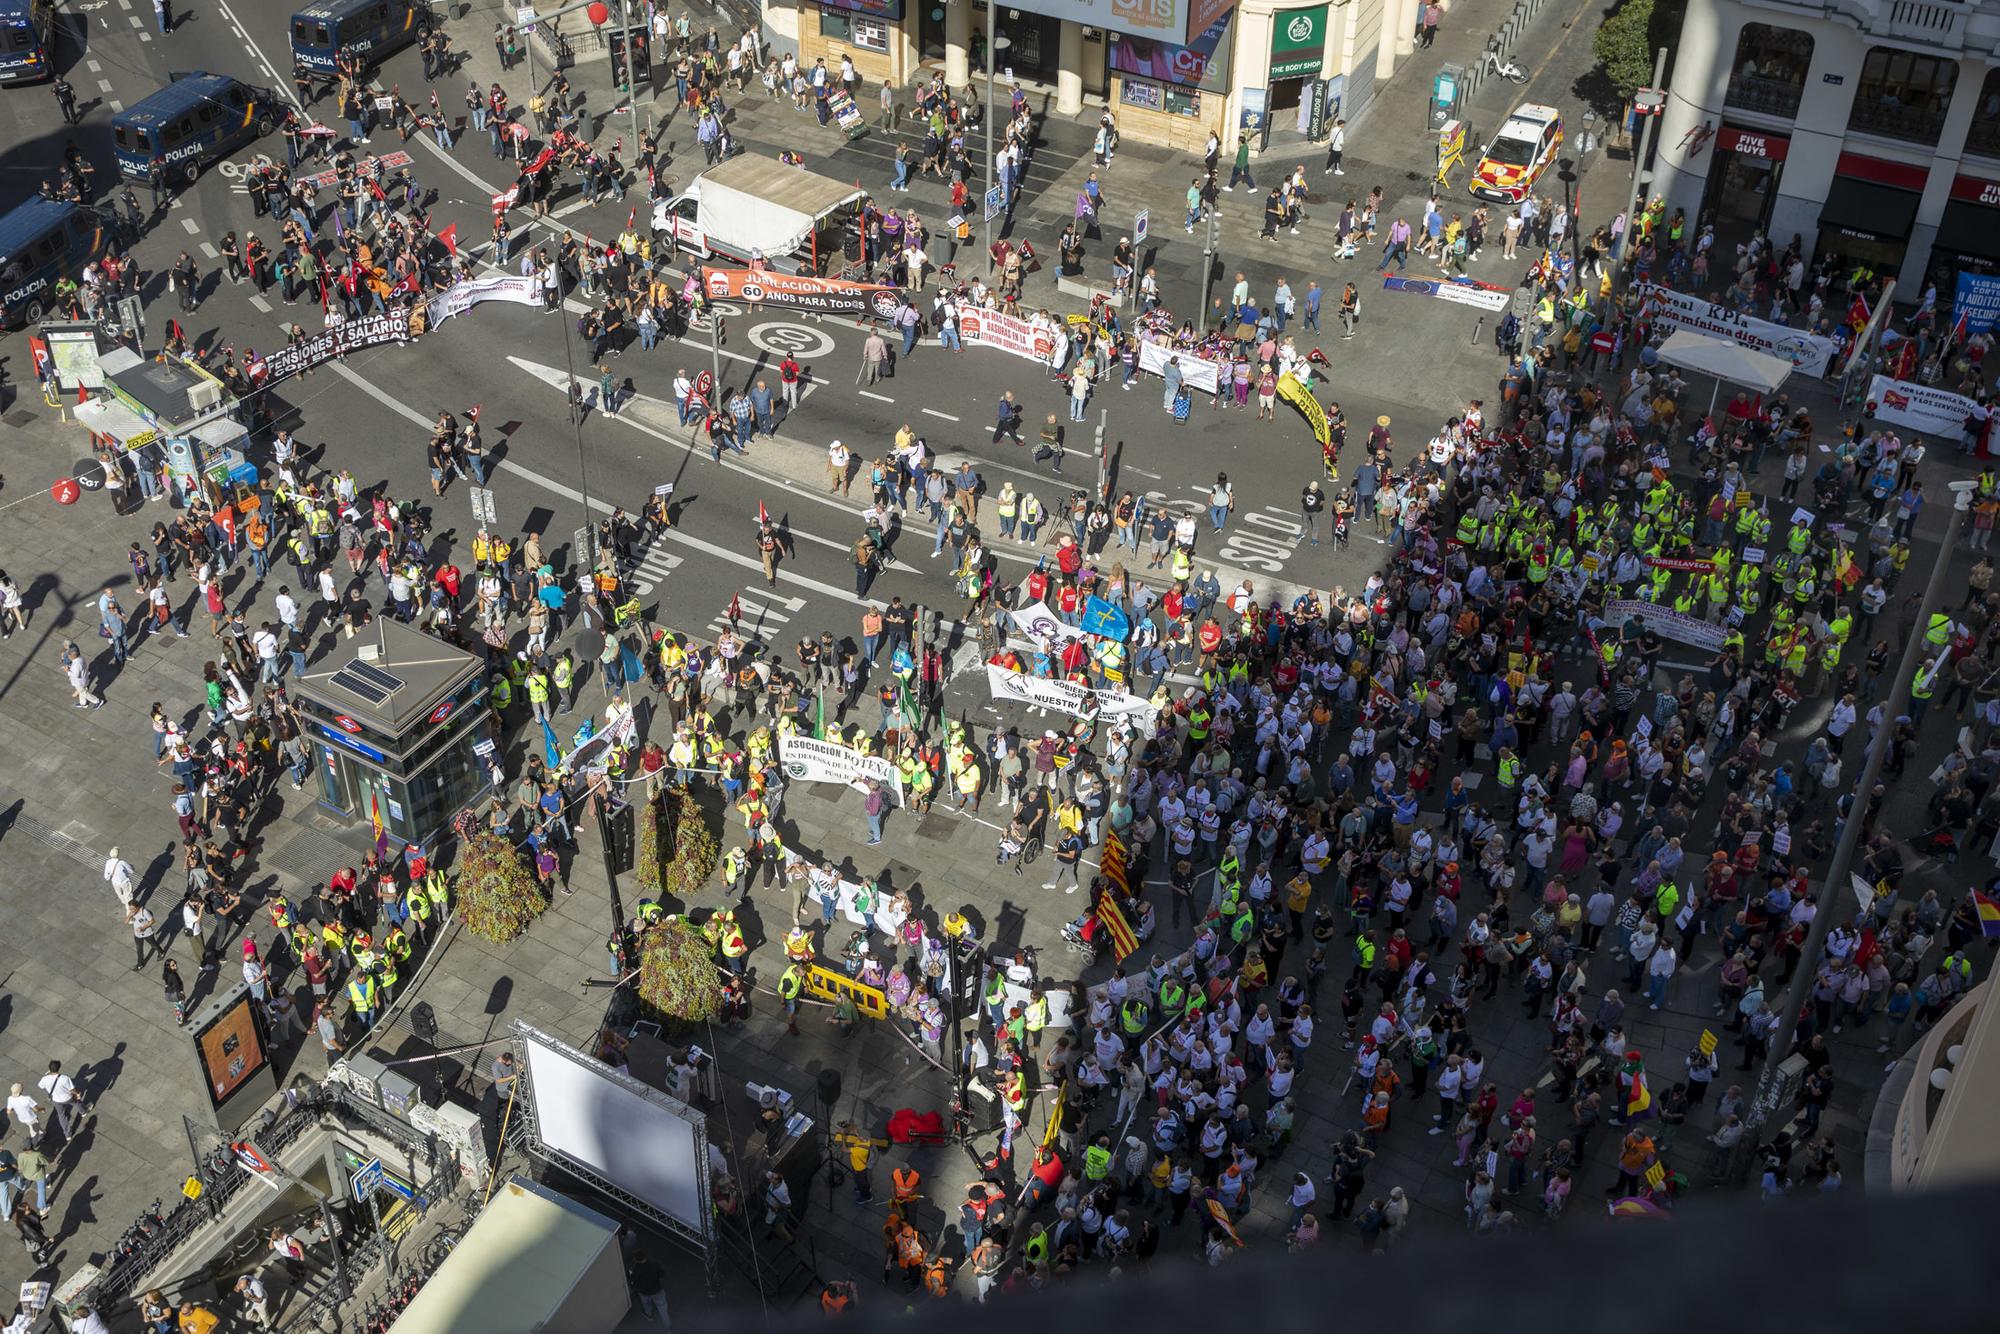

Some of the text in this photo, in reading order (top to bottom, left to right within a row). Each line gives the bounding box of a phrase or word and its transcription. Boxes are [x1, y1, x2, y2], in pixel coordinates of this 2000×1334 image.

[295, 52, 335, 67] POLICÍA
[1176, 50, 1217, 76] Cris
[1271, 60, 1321, 73] THE BODY SHOP
[1314, 96, 1322, 116] BODY
[1312, 116, 1320, 137] SHOP
[1735, 143, 1766, 157] GUYS
[1739, 135, 1765, 147] FIVE
[165, 141, 203, 164] POLICÍA
[712, 288, 729, 296] CGT
[743, 286, 866, 311] 60 AÑOS PARA TOD@S
[825, 285, 834, 294] A
[838, 286, 863, 297] LOS
[1667, 298, 1694, 312] real
[1966, 293, 2000, 308] AUDITO
[390, 308, 410, 319] DE
[766, 329, 814, 351] 30
[962, 329, 979, 339] CGT
[987, 321, 1026, 345] BASURAS EN LA
[1681, 313, 1734, 338] mínima
[1734, 330, 1774, 350] digna
[267, 316, 409, 374] PENSIONES Y SALARIOS
[274, 331, 411, 377] CON EL IPC REAL
[1900, 385, 1914, 395] POR
[1926, 391, 1957, 405] DEFENSA
[1919, 398, 1932, 407] LOS
[1934, 401, 1970, 416] SERVICIO
[79, 476, 99, 488] CGT
[60, 487, 72, 502] CGT
[1219, 512, 1303, 572] SOLO
[1651, 558, 1711, 570] TORRELAVEGA
[1610, 600, 1673, 620] COORDINADORA
[1623, 607, 1664, 621] PENSIONES
[1097, 690, 1125, 704] QUIEN
[1375, 693, 1400, 714] CGT
[1771, 689, 1797, 709] CGT
[787, 739, 841, 757] ASOCIACIÓN
[233, 1150, 263, 1167] Metro
